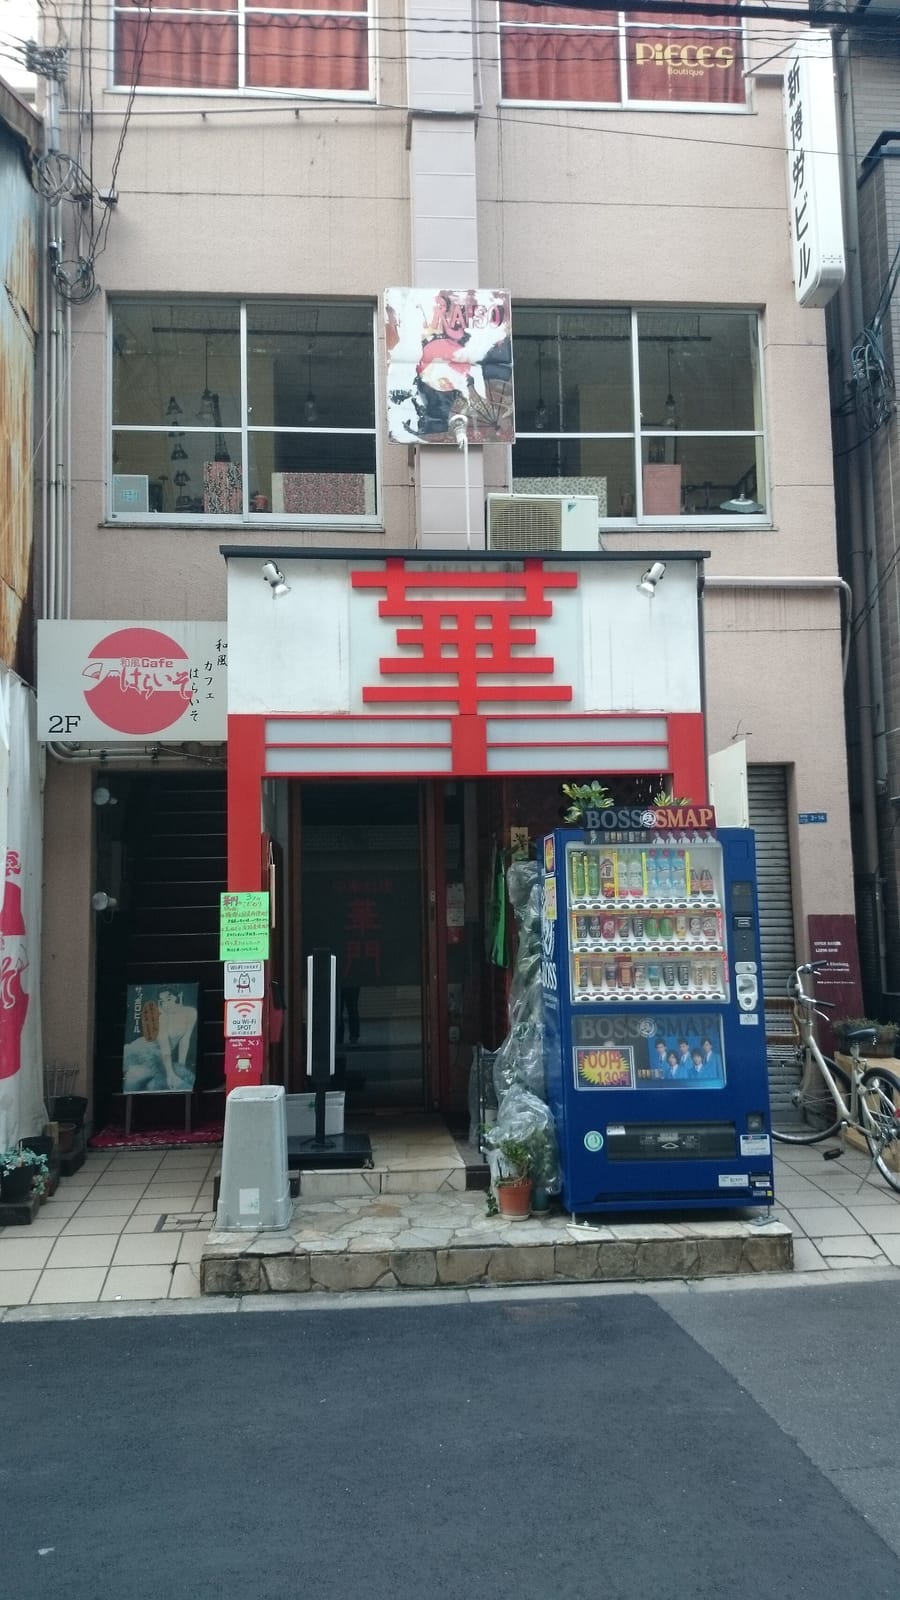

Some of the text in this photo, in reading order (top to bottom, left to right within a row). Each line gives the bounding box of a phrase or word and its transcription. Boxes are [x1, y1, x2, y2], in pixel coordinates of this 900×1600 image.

[667, 67, 704, 77] Boutique
[203, 660, 215, 699] カフェ
[189, 668, 200, 722] はらいそ
[48, 715, 81, 734] 2F
[585, 807, 714, 829] BOSS SMAP
[579, 1018, 640, 1039] BOSS
